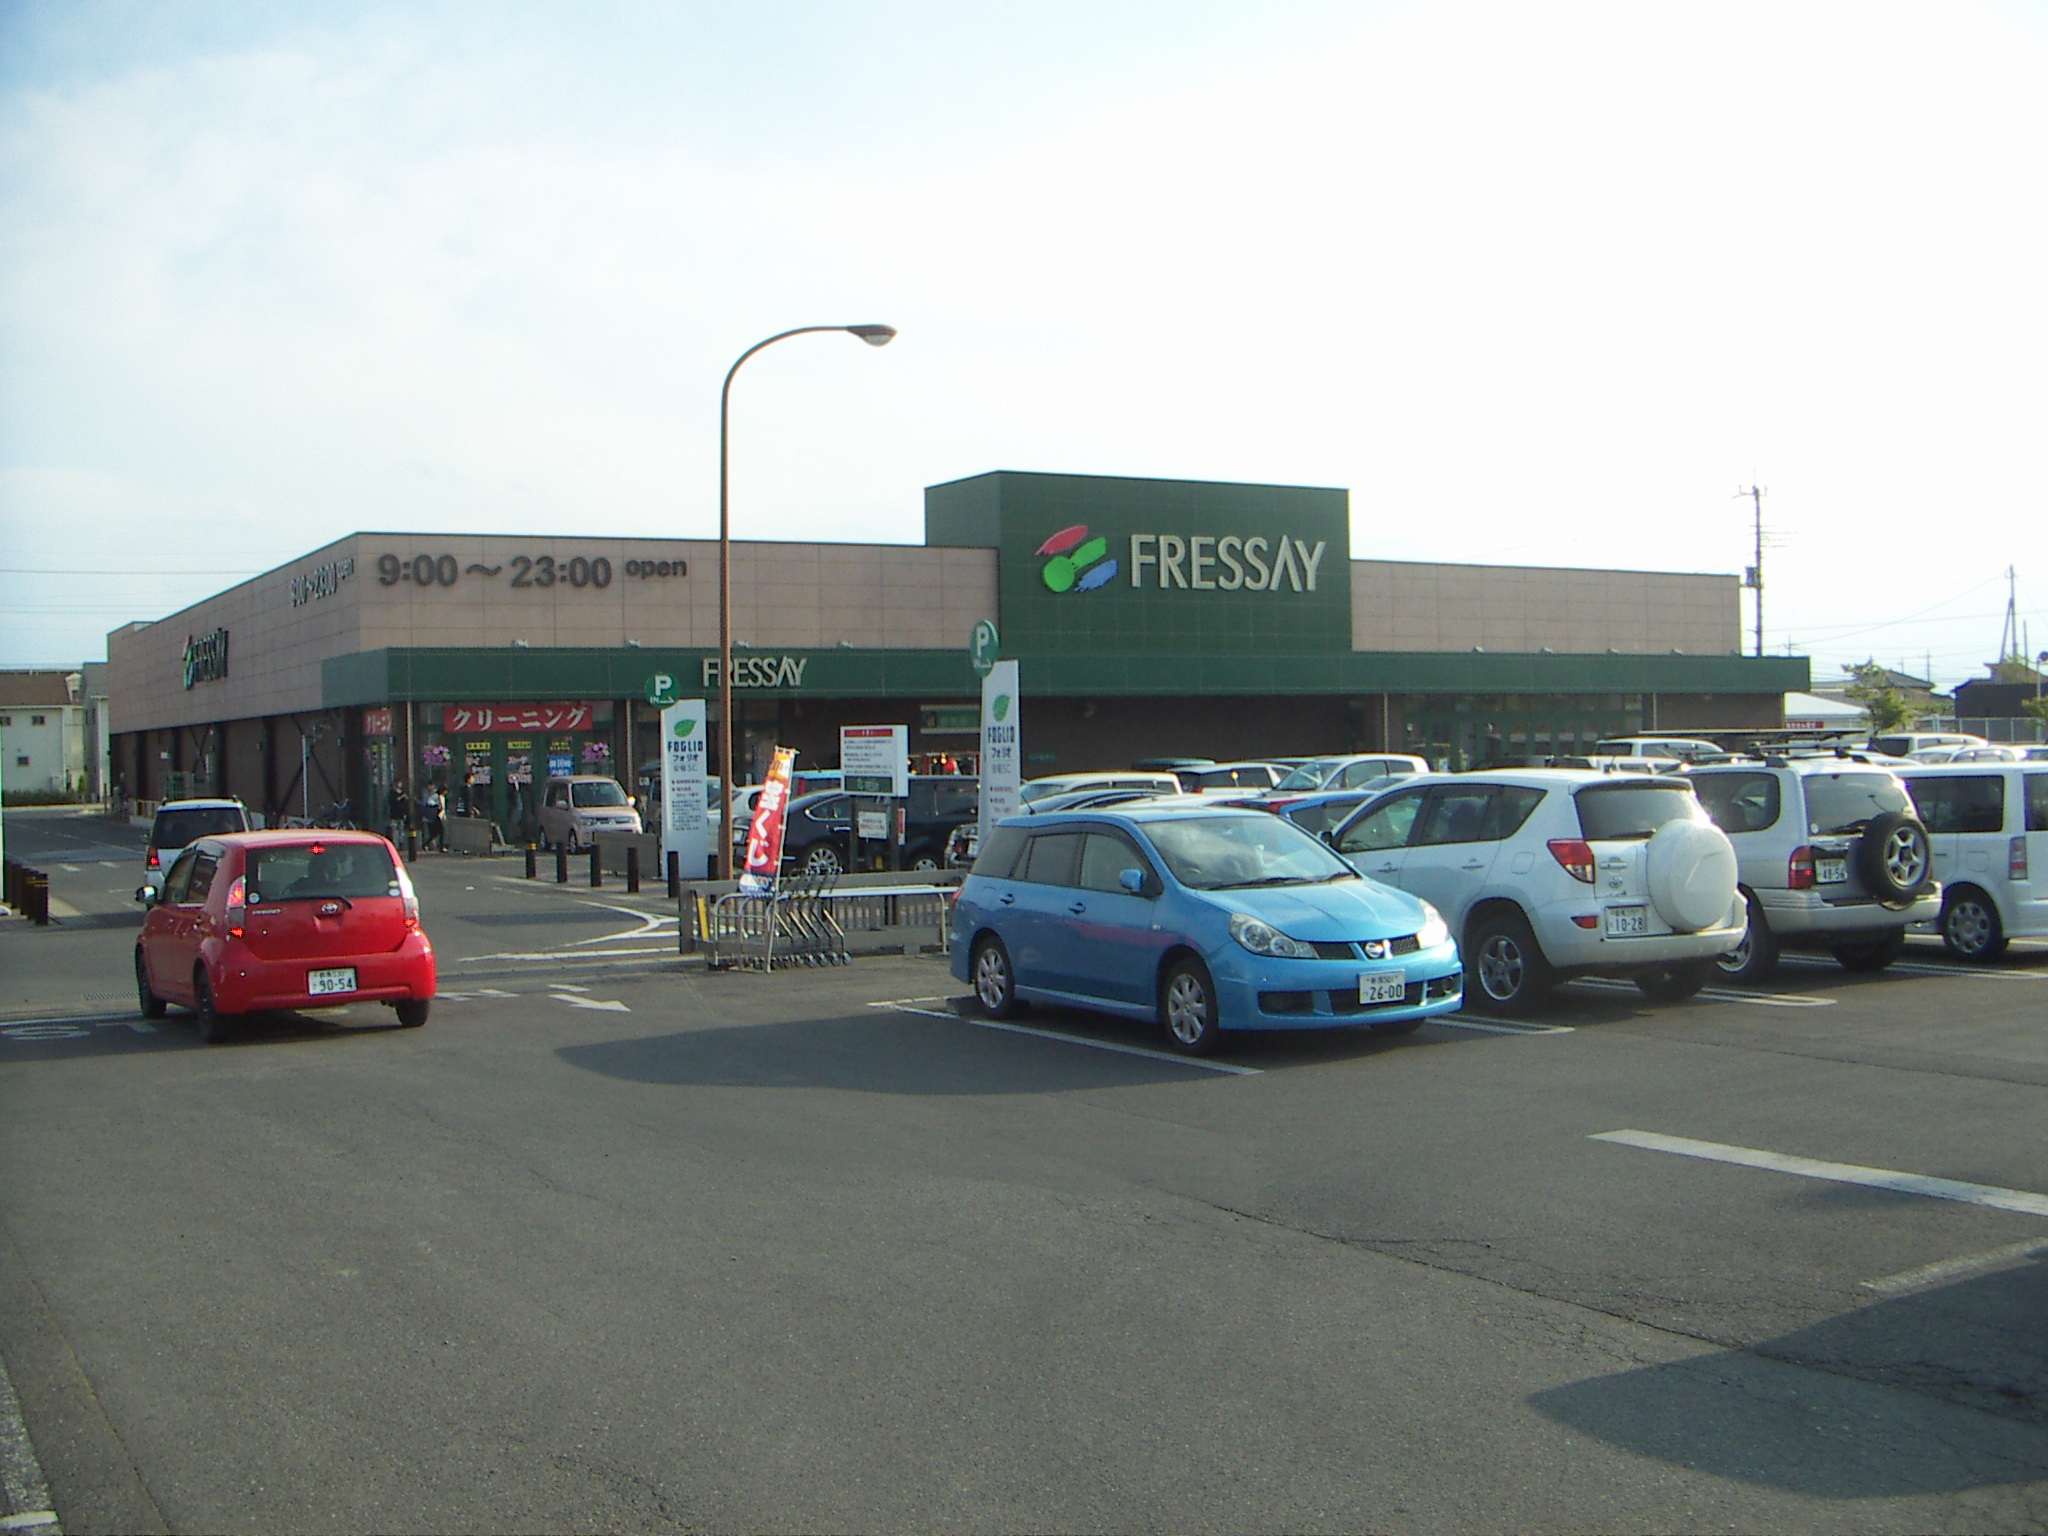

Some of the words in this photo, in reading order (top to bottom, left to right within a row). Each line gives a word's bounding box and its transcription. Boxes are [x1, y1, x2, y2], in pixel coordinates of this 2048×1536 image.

[625, 559, 688, 580] open
[1130, 534, 1327, 593] FRESSAY
[976, 625, 990, 658] P
[654, 675, 674, 697] P
[453, 706, 588, 732] クリーニング
[667, 740, 704, 753] FOGLIO
[1615, 917, 1643, 931] 10-28
[319, 977, 353, 992] 90-54
[1370, 984, 1403, 1001] 26-00
